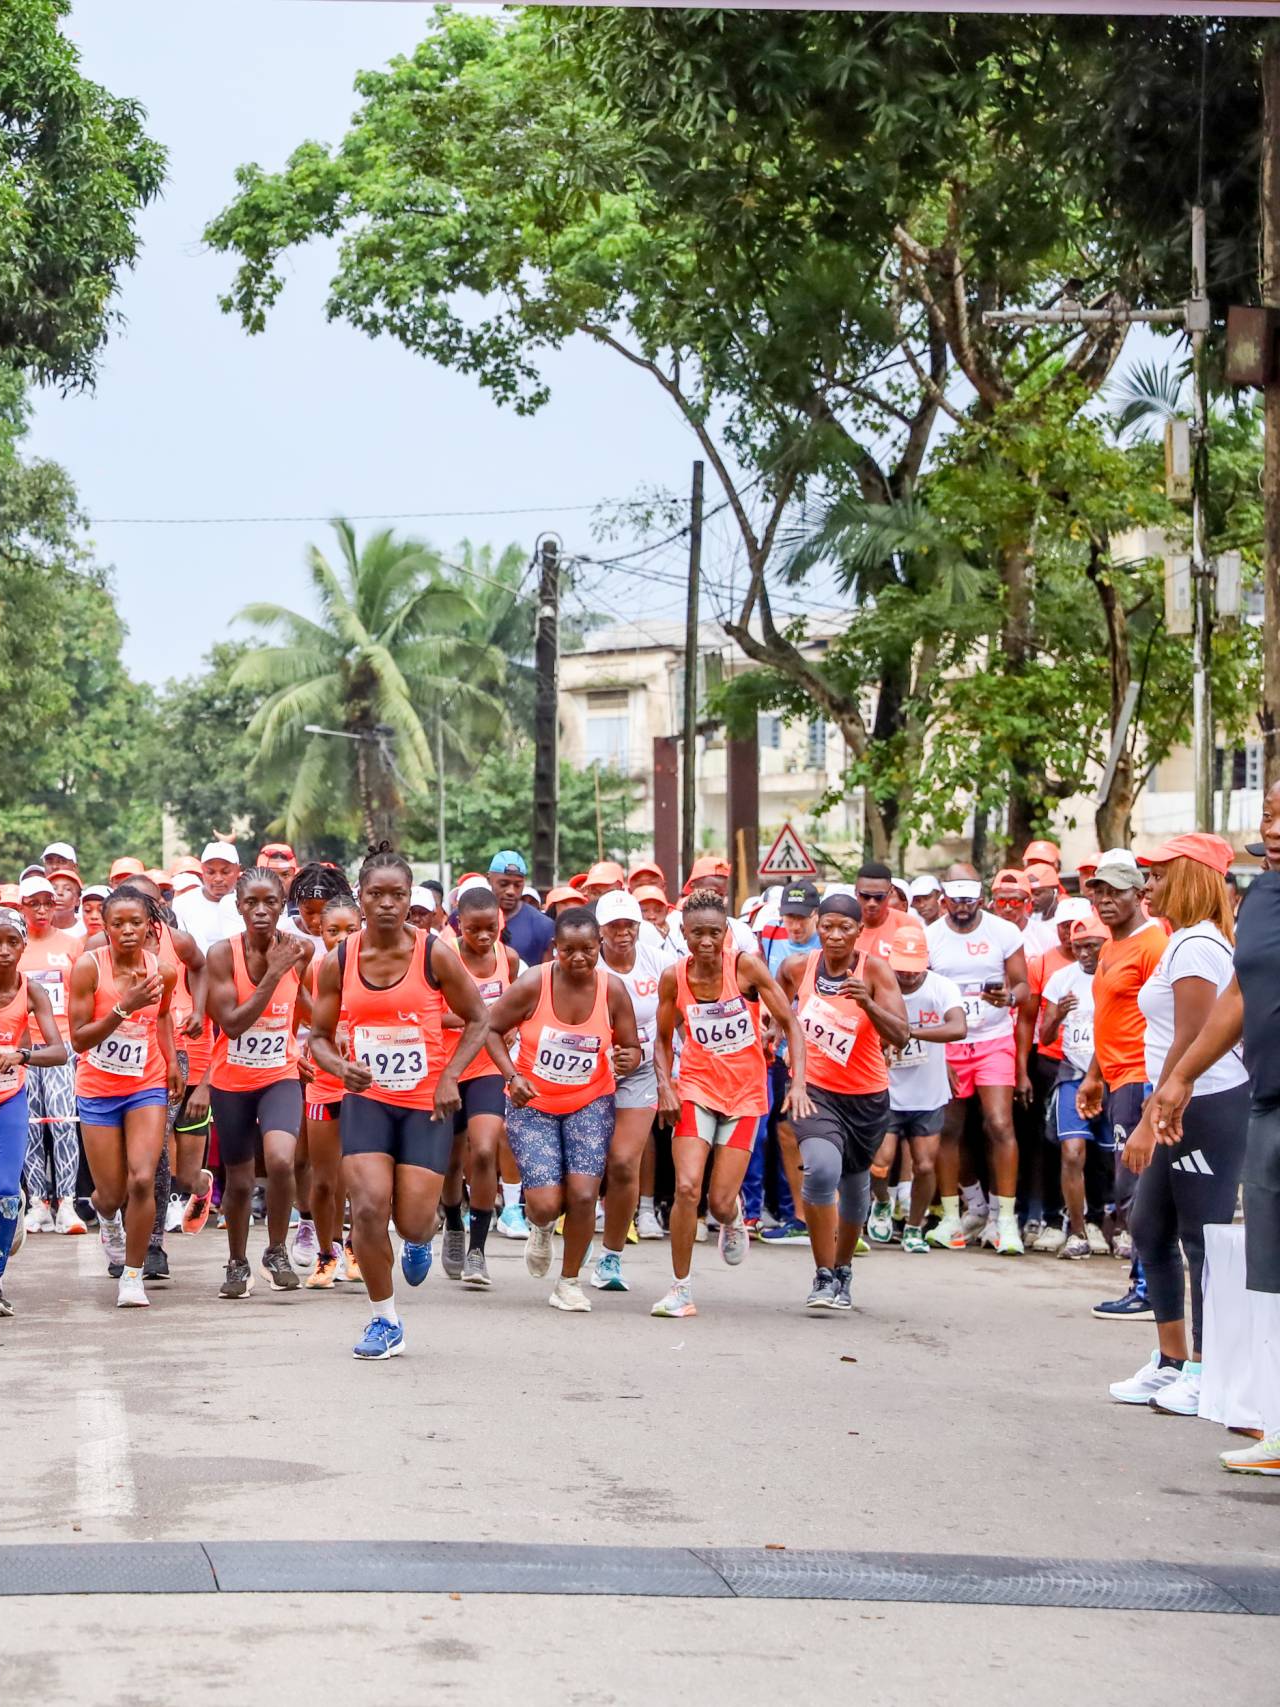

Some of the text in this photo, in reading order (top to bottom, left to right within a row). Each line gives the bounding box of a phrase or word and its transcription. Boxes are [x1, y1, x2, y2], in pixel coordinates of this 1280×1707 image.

[966, 941, 989, 955] be
[919, 1009, 939, 1024] be
[695, 1018, 748, 1045] 0669
[803, 1018, 848, 1055] 1914
[96, 1041, 142, 1064] 1901
[237, 1035, 285, 1055] 1922
[361, 1051, 423, 1075] 1923
[540, 1049, 593, 1073] 0079
